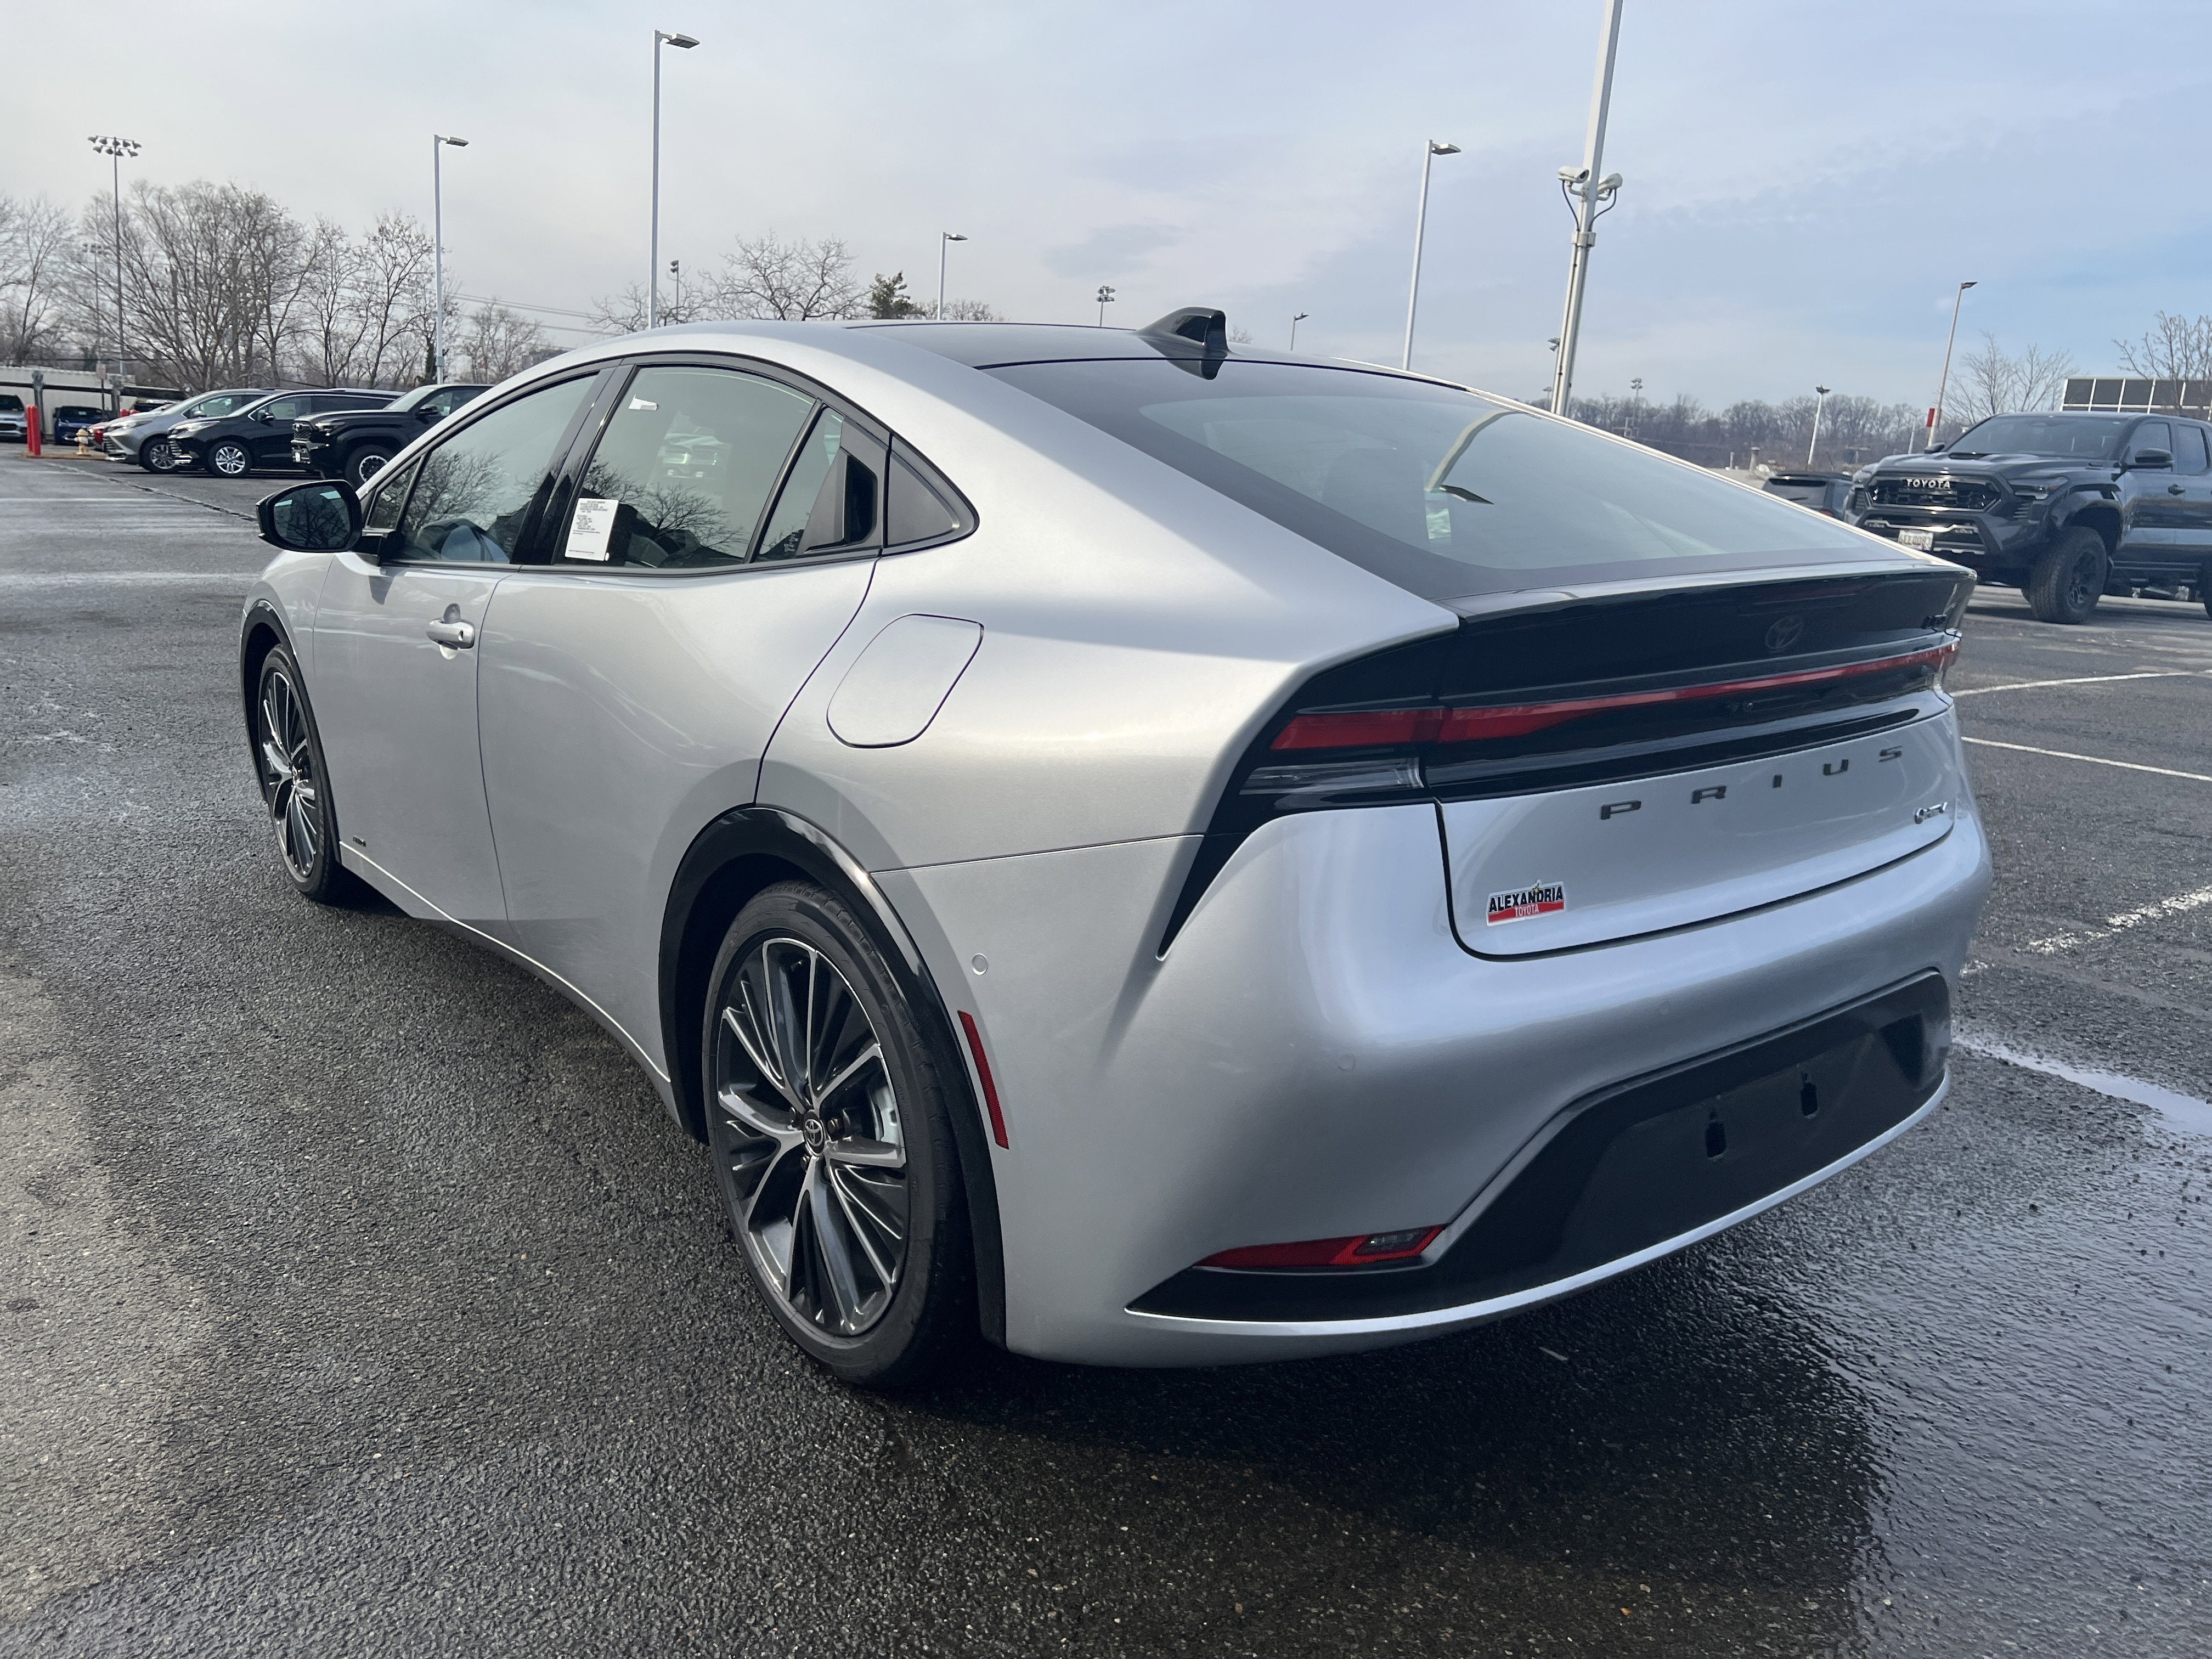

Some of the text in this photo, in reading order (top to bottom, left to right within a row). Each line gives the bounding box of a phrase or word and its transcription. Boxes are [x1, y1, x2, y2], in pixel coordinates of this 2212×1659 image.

[1906, 478, 1950, 489] TOYOTA
[1600, 746, 1903, 820] PRIUS
[1489, 886, 1564, 912] ALEXANDRIA
[1514, 904, 1540, 917] TOYOTA
